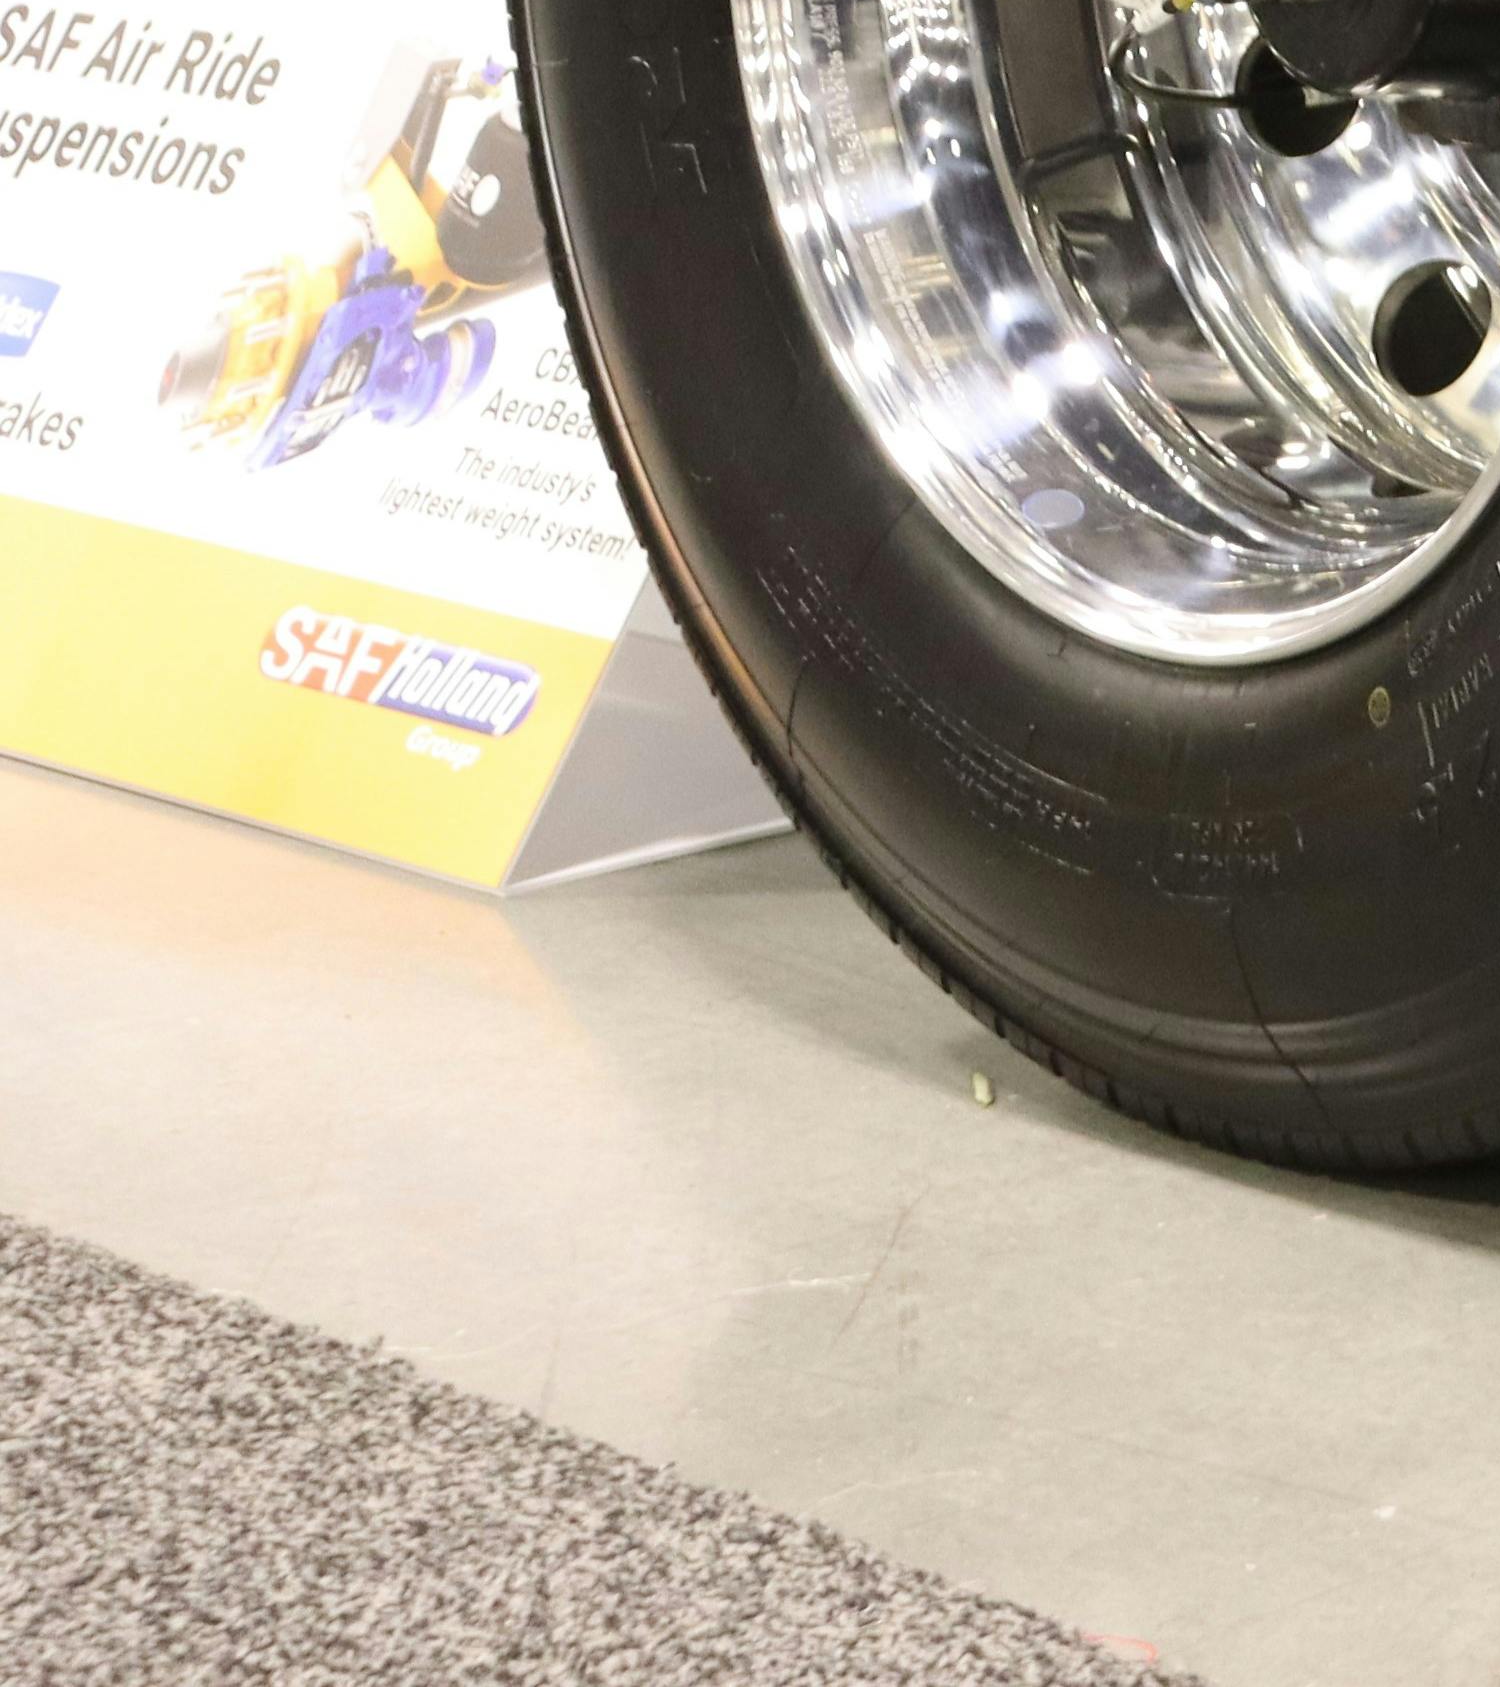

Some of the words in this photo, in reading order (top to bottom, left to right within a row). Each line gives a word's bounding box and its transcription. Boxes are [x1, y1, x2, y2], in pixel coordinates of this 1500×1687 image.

[0, 3, 94, 72] SAF
[82, 19, 165, 86] Air
[164, 29, 281, 106] Ride
[0, 389, 84, 451] akes
[481, 387, 600, 441] AeroBea
[456, 446, 496, 481] The
[497, 456, 598, 506] industy's
[378, 476, 464, 520] lightest
[463, 502, 541, 541] weight
[541, 518, 636, 561] system!
[260, 605, 400, 700] SAF
[370, 633, 541, 737] Holland
[406, 724, 481, 772] Group
